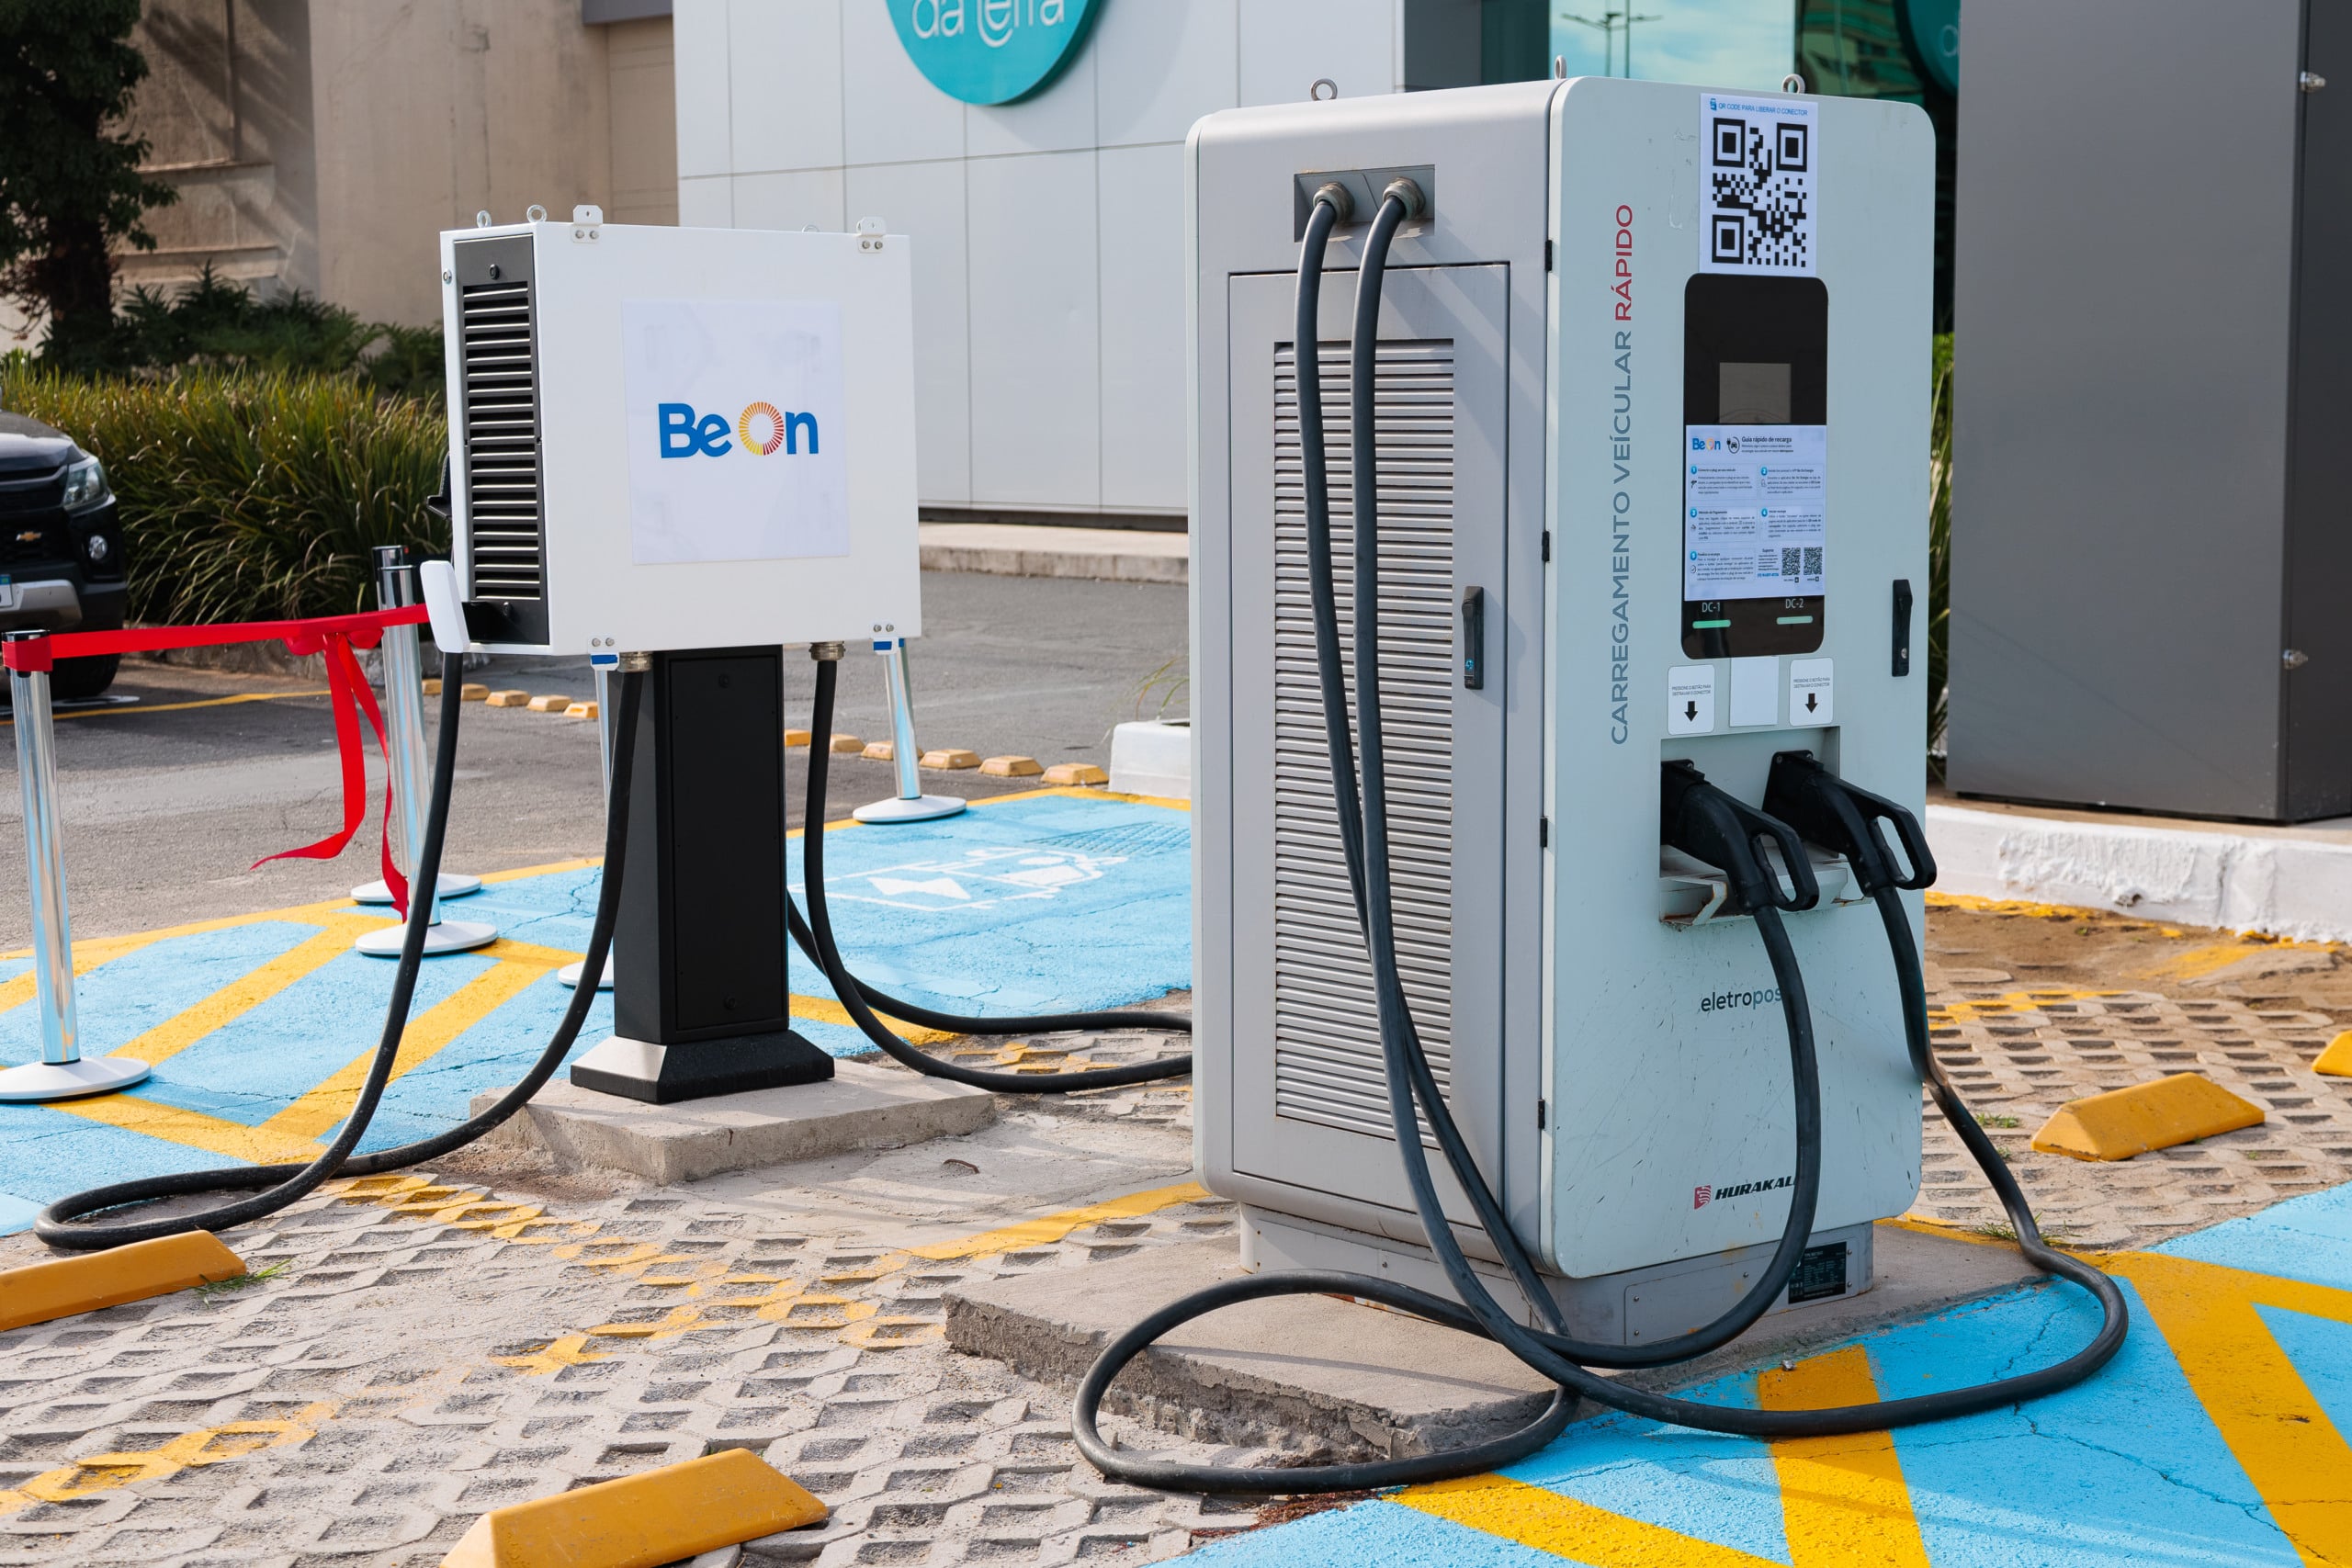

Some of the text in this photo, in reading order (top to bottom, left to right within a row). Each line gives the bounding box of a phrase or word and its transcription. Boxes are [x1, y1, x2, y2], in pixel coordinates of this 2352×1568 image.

[1727, 103, 1741, 111] CODE
[1756, 106, 1776, 114] LIBERAR
[1781, 107, 1808, 116] CONECTOR
[1609, 204, 1634, 745] CARREGAMENTO VEÍCULAR RÁPIDO
[1702, 602, 1721, 613] DC-1
[1785, 598, 1804, 609] DC-2
[1701, 987, 1783, 1012] eletropos
[1714, 1175, 1795, 1201] HURAKAL
